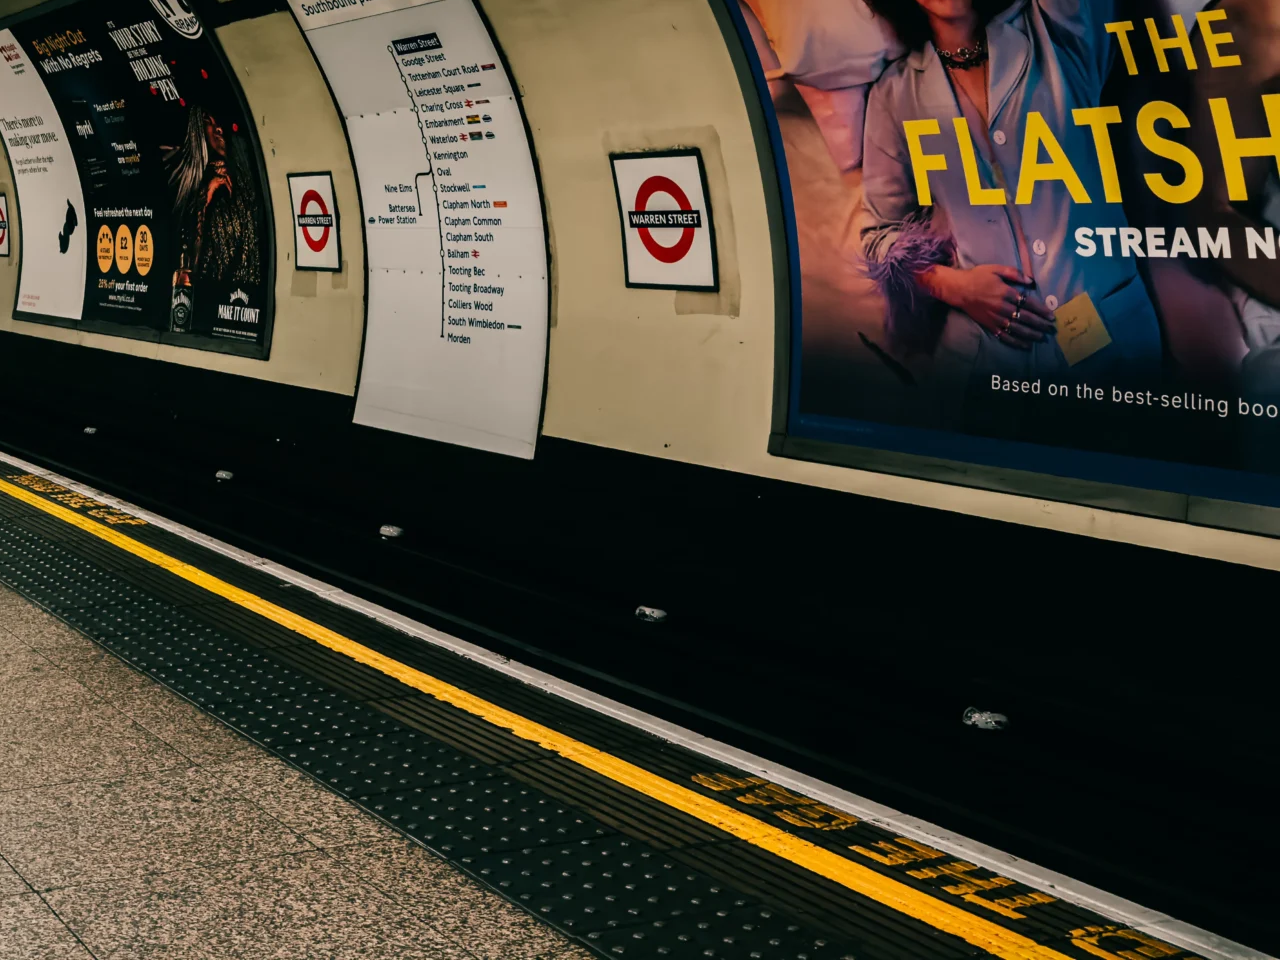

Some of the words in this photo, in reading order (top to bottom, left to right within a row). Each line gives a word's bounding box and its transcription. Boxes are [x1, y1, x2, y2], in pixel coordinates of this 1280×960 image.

[108, 27, 138, 51] YOUR
[130, 20, 163, 46] STORY
[1104, 9, 1242, 75] THE
[31, 39, 51, 57] Big
[44, 32, 67, 53] Night
[66, 28, 87, 47] Out
[395, 41, 418, 52] Warren
[419, 37, 439, 48] Street
[40, 56, 60, 75] With
[59, 52, 72, 70] No
[68, 48, 103, 69] Regrets
[401, 57, 425, 67] Goodge
[425, 53, 446, 64] Street
[129, 54, 172, 82] HOLDING
[408, 70, 440, 82] Tottenham
[442, 67, 460, 77] Court
[461, 63, 480, 73] Road
[157, 78, 180, 101] PEN
[414, 86, 442, 97] Leicester
[443, 84, 465, 95] Square
[421, 103, 444, 113] Charing
[445, 100, 464, 110] Cross
[21, 118, 37, 128] more
[425, 117, 464, 129] Embankment
[8, 133, 29, 149] making
[27, 136, 41, 149] your
[429, 134, 458, 144] Waterloo
[433, 150, 468, 161] Kennington
[902, 93, 1280, 206] FLATSH
[437, 167, 452, 176] Oval
[384, 184, 398, 193] Nine
[399, 184, 412, 192] Elms
[440, 183, 470, 192] Stockwell
[389, 204, 415, 213] Battersea
[443, 200, 469, 210] Clapham
[471, 200, 491, 208] North
[93, 207, 103, 218] Feel
[103, 207, 124, 218] refreshed
[124, 207, 133, 218] the
[133, 207, 144, 217] next
[144, 206, 153, 219] day
[631, 214, 667, 224] WARREN
[667, 214, 698, 224] STREET
[299, 217, 315, 225] WARREN
[315, 217, 332, 225] STREET
[378, 216, 395, 224] Power
[396, 215, 417, 224] Station
[445, 216, 471, 227] Clapham
[473, 217, 502, 226] Common
[140, 231, 148, 244] 30
[446, 232, 472, 243] Clapham
[474, 232, 494, 241] South
[1074, 227, 1231, 258] STREAM
[447, 249, 469, 258] Balham
[448, 266, 471, 277] Tooting
[473, 266, 485, 276] Bec
[115, 282, 125, 292] your
[125, 280, 136, 291] first
[135, 282, 148, 293] order
[448, 282, 471, 294] Tooting
[473, 283, 504, 296] Broadway
[448, 299, 472, 310] Colliers
[474, 301, 493, 311] Wood
[217, 304, 233, 320] MAKE
[233, 306, 241, 321] IT
[240, 307, 260, 324] COUNT
[448, 316, 466, 326] South
[468, 318, 505, 330] Wimbledon
[447, 333, 471, 344] Morden
[991, 375, 1041, 395] Based
[1048, 383, 1069, 397] on
[1076, 383, 1104, 400] the
[1112, 386, 1229, 418] best-selling
[1239, 397, 1278, 419] boo
[690, 772, 861, 832] GAP
[848, 838, 1061, 921] THE
